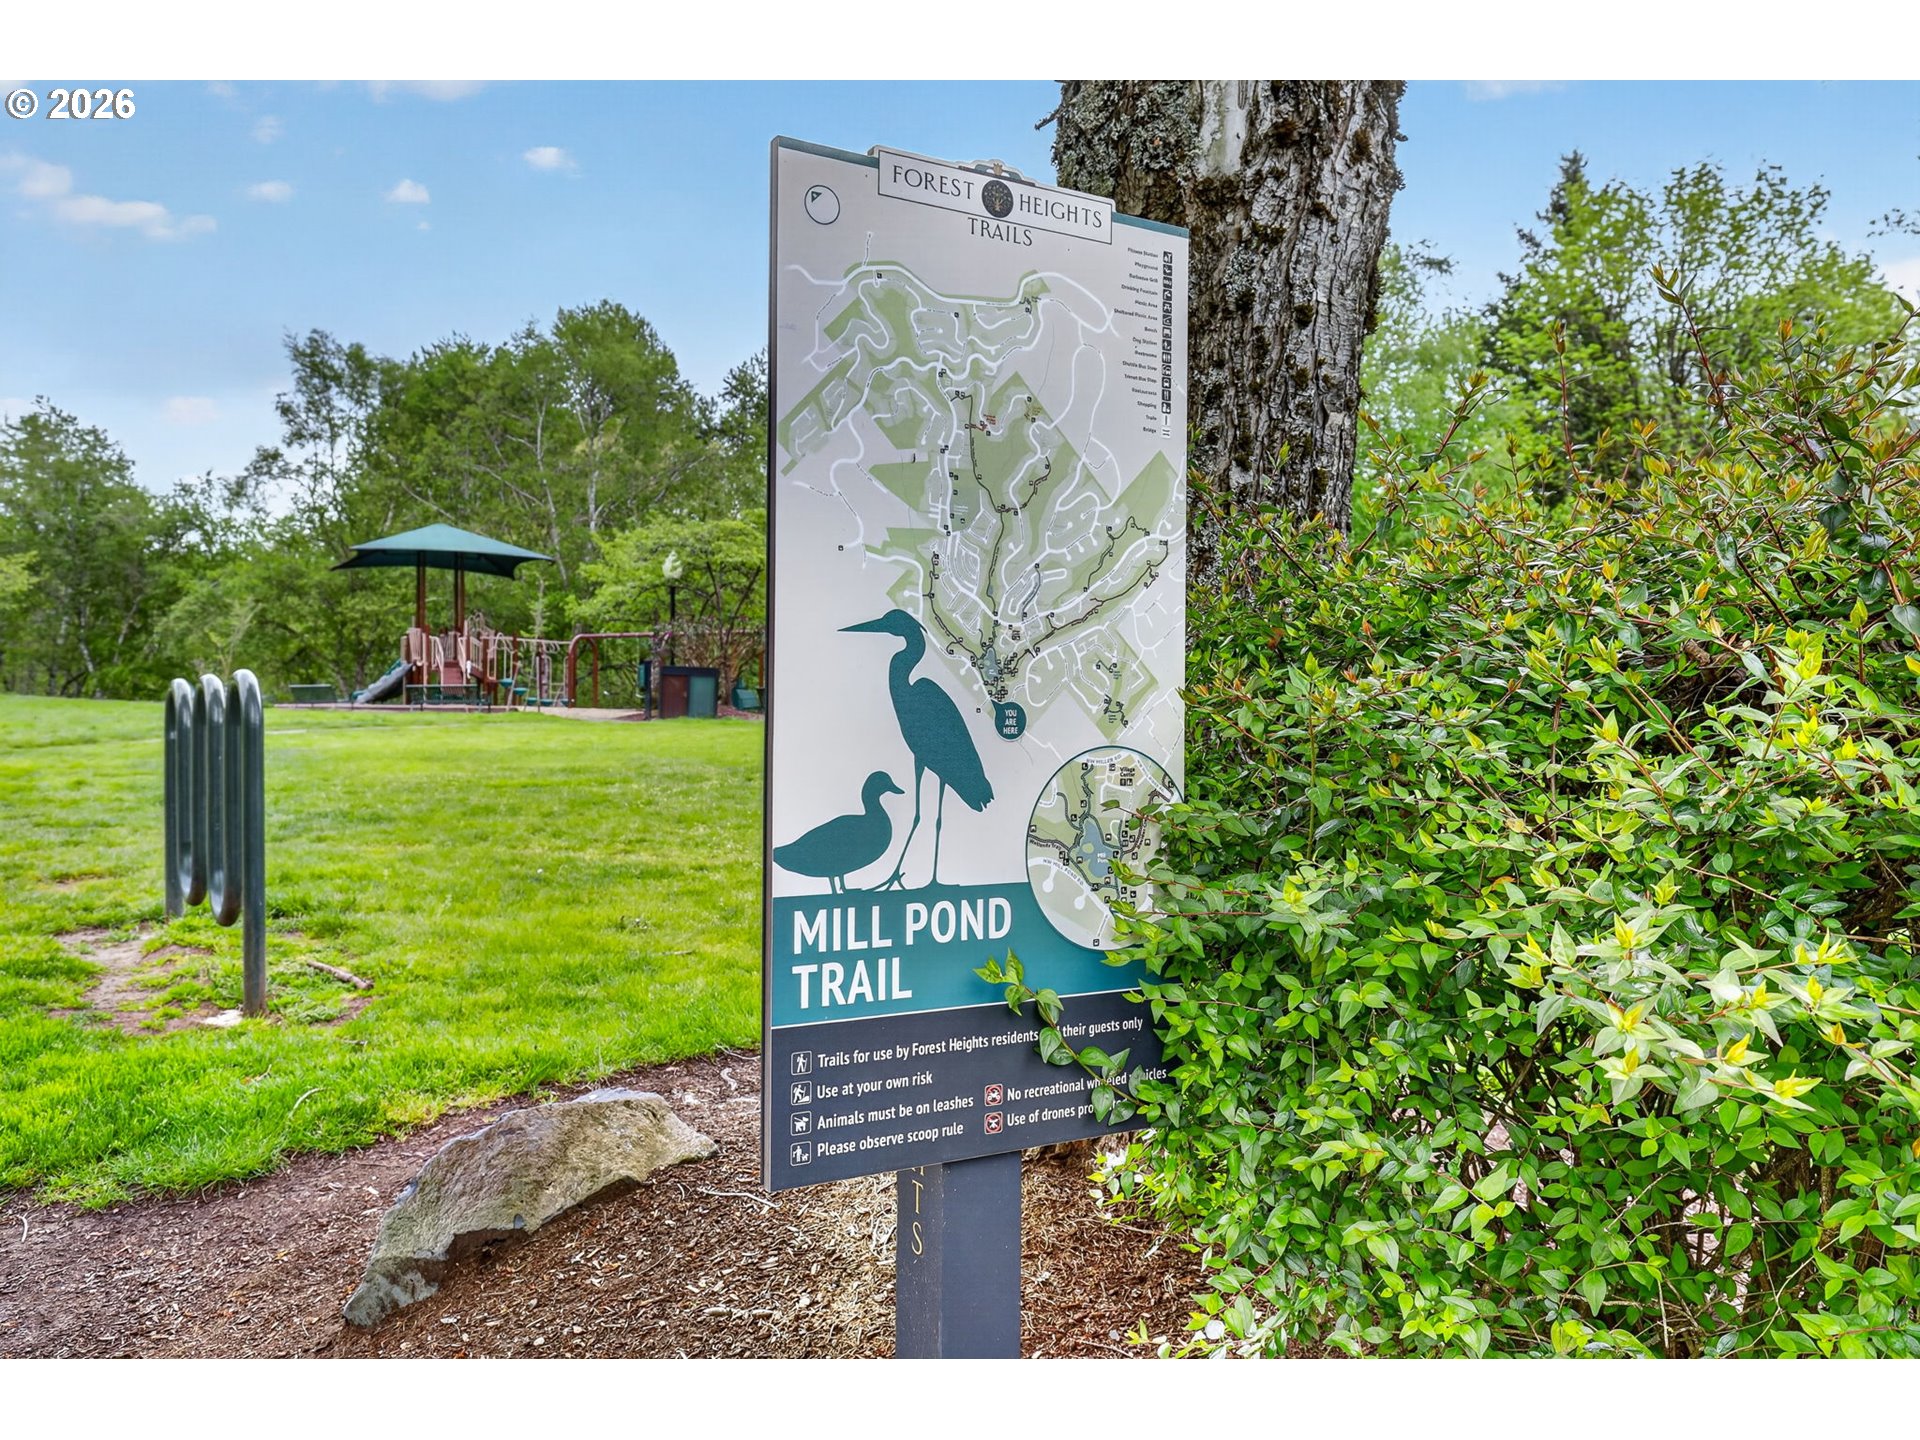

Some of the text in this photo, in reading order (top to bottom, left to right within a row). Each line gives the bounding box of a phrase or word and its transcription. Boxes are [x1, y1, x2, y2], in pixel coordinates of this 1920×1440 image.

[893, 164, 1103, 229] FOREST HEIGHTS
[967, 216, 1033, 247] TRAILS
[1134, 261, 1158, 270] Playground
[1121, 284, 1158, 296] Drinking Fountain
[1114, 308, 1134, 317] Sheltered
[1132, 336, 1142, 345] Dog
[1122, 360, 1138, 368] Shuttle
[1137, 400, 1157, 410] Shopping
[1004, 709, 1018, 717] YOU
[1004, 718, 1017, 726] ARE
[1003, 726, 1019, 735] HERE
[793, 897, 1012, 955] MILL POND
[791, 957, 913, 1010] TRAIL
[818, 1016, 1144, 1068] Trails for use by Forest Heights residents their guests only
[817, 1070, 933, 1099] Use at your own risk
[1007, 1087, 1022, 1102] No
[1024, 1078, 1085, 1099] recreational
[1086, 1072, 1127, 1089] wheled
[817, 1095, 974, 1130] Animals must be on leashes
[1007, 1113, 1025, 1127] Use
[1028, 1110, 1040, 1123] of
[1041, 1105, 1076, 1121] drones
[817, 1121, 964, 1157] Please observe scoop rule
[911, 1166, 925, 1255] TS
